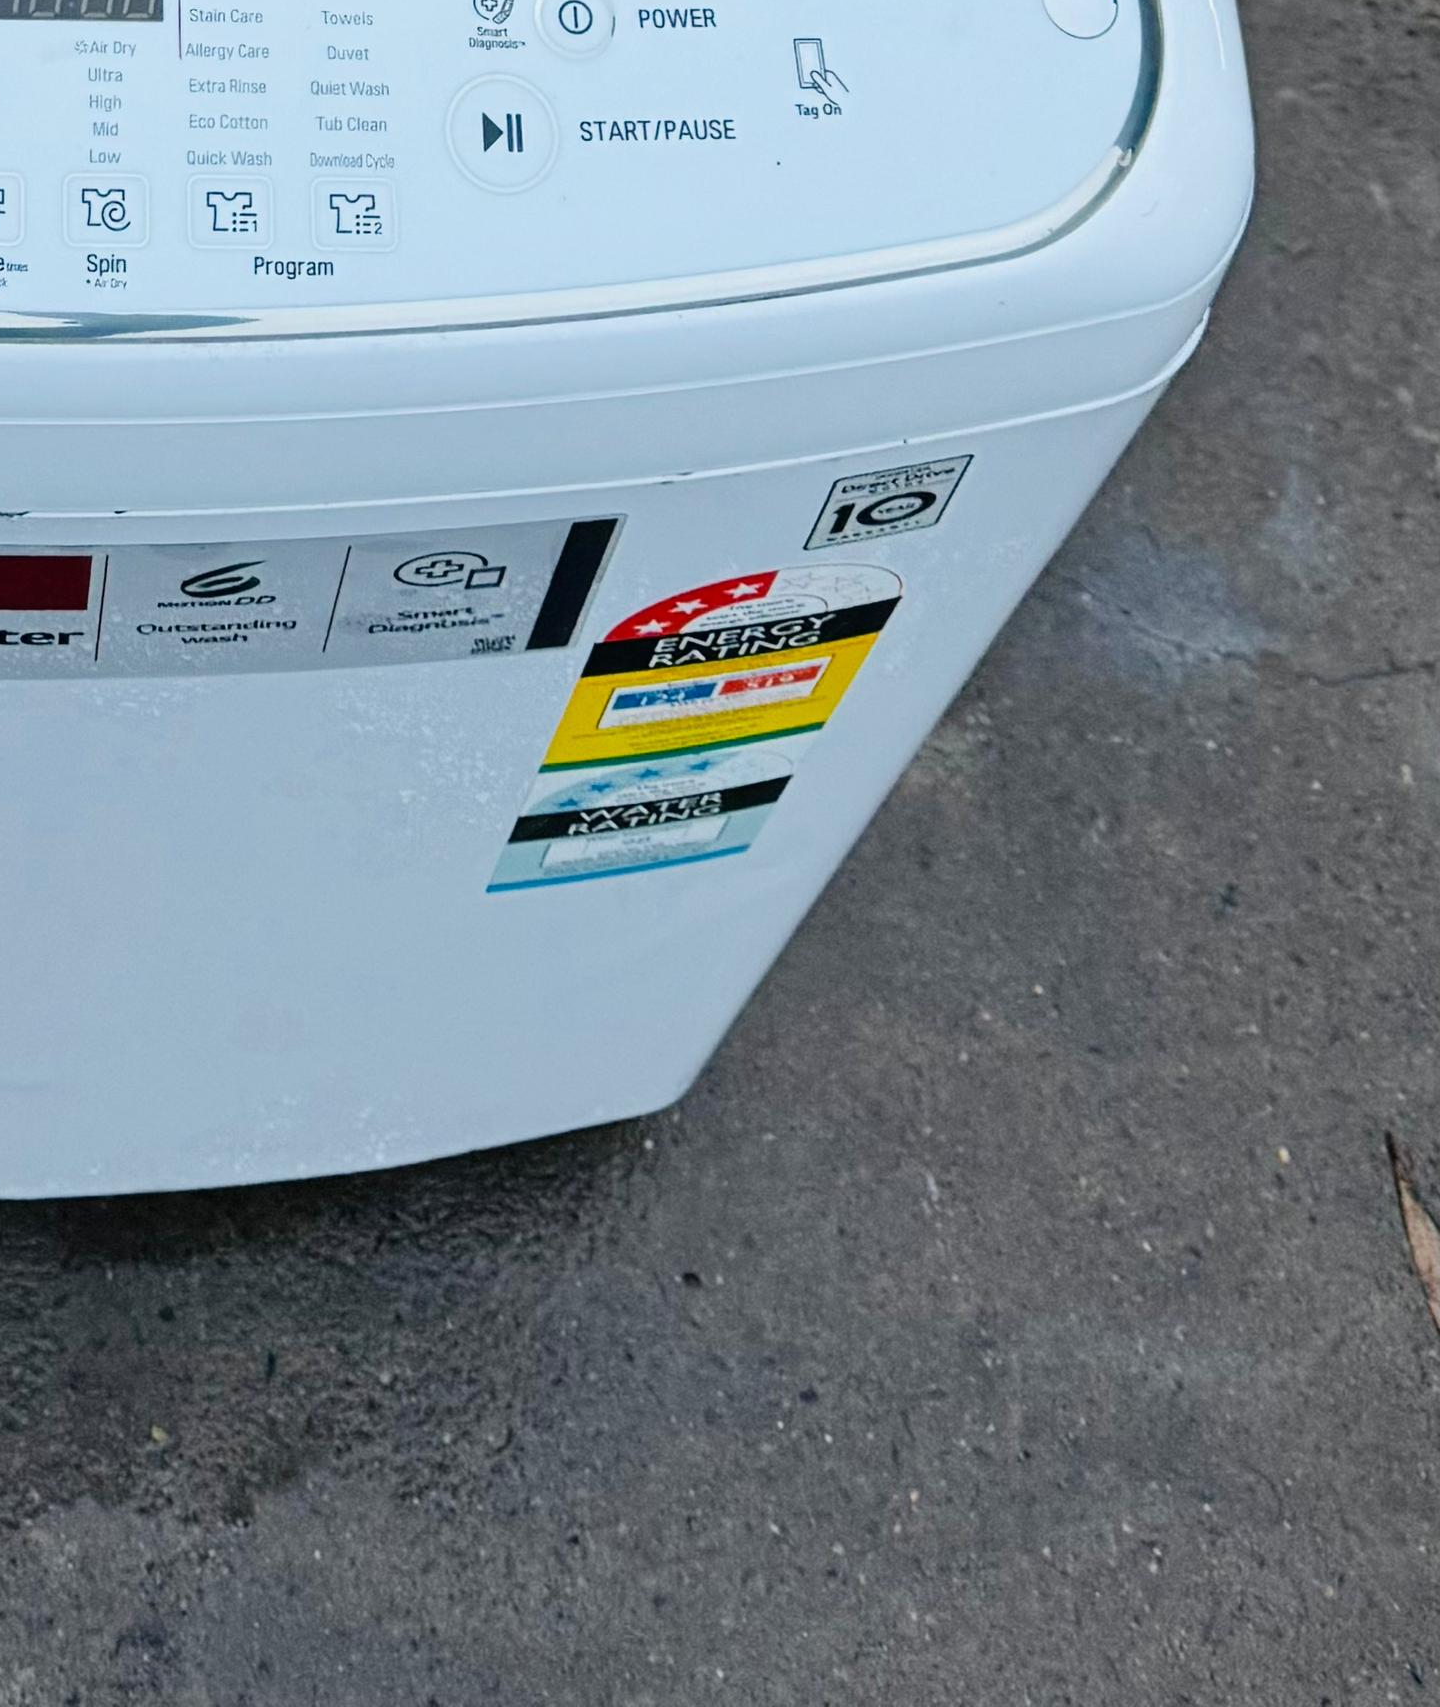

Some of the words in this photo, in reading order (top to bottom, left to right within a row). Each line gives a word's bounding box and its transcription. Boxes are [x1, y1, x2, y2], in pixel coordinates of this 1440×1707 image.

[190, 9, 226, 24] Stain
[230, 9, 263, 25] Care
[321, 11, 374, 26] Towels
[638, 8, 716, 29] POWER
[477, 27, 507, 36] Smart
[90, 40, 108, 55] Air
[113, 41, 136, 57] Dry
[185, 43, 234, 61] Allergy
[238, 44, 269, 60] Care
[327, 46, 369, 61] Duvet
[88, 67, 123, 83] Ultra
[189, 79, 225, 94] Extra
[230, 79, 266, 94] Rinse
[311, 81, 346, 98] Quiet
[349, 82, 389, 97] Wash
[89, 94, 122, 111] High
[795, 103, 818, 119] Tag
[822, 103, 842, 117] On
[93, 121, 118, 136] Mid
[189, 115, 216, 130] Eco
[220, 115, 268, 130] Cotton
[316, 117, 342, 132] Tub
[347, 117, 387, 133] Clean
[580, 119, 736, 141] START/PAUSE
[89, 149, 121, 164] Low
[186, 151, 227, 166] Quick
[231, 151, 272, 167] Wash
[310, 153, 363, 169] Download
[366, 153, 395, 170] Cycle
[87, 254, 126, 276] Spin
[254, 256, 333, 279] Program
[95, 279, 107, 288] Air
[110, 279, 127, 289] Dry
[830, 492, 936, 534] 10
[398, 607, 473, 621] Smart
[136, 619, 296, 635] Outstanding
[655, 614, 837, 653] ENERGY
[649, 631, 821, 668] RATING
[581, 793, 722, 822] WATER
[568, 806, 721, 836] RATING
